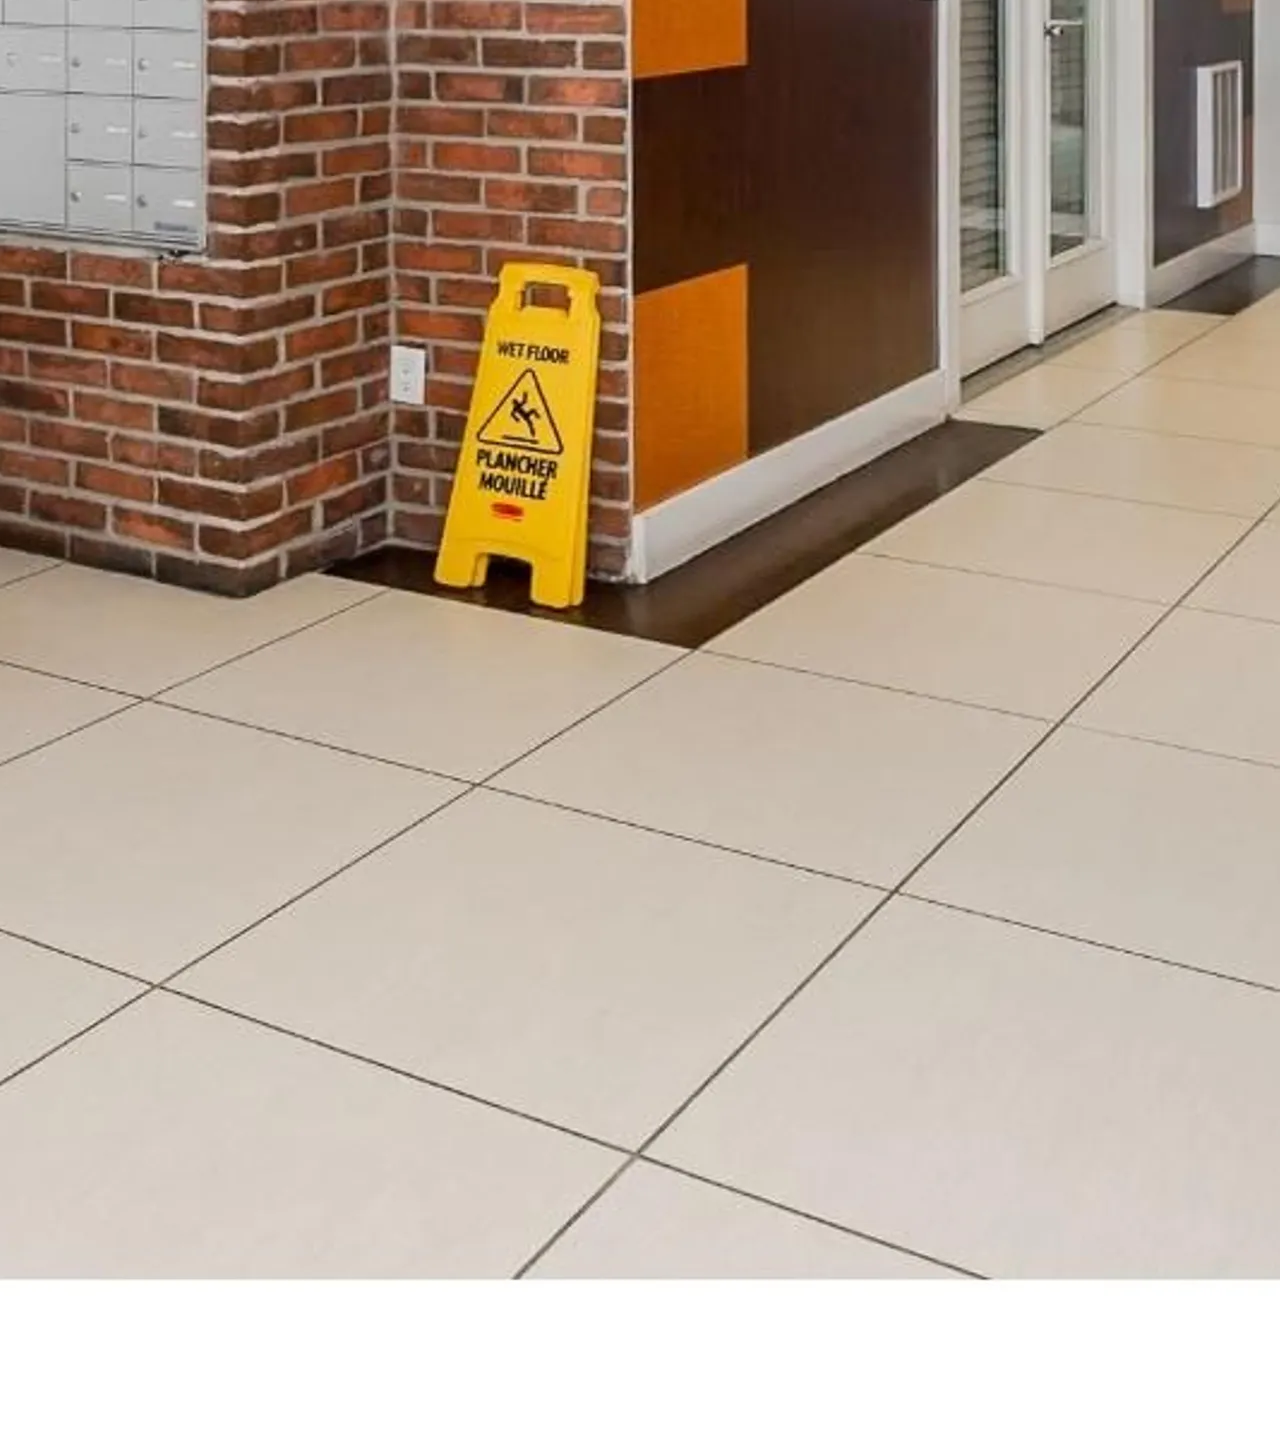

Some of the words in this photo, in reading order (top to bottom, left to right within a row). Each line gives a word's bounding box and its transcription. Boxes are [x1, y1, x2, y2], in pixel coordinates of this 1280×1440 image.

[496, 340, 525, 359] WET
[526, 345, 570, 364] FLOOR
[476, 448, 558, 480] PLANCHER
